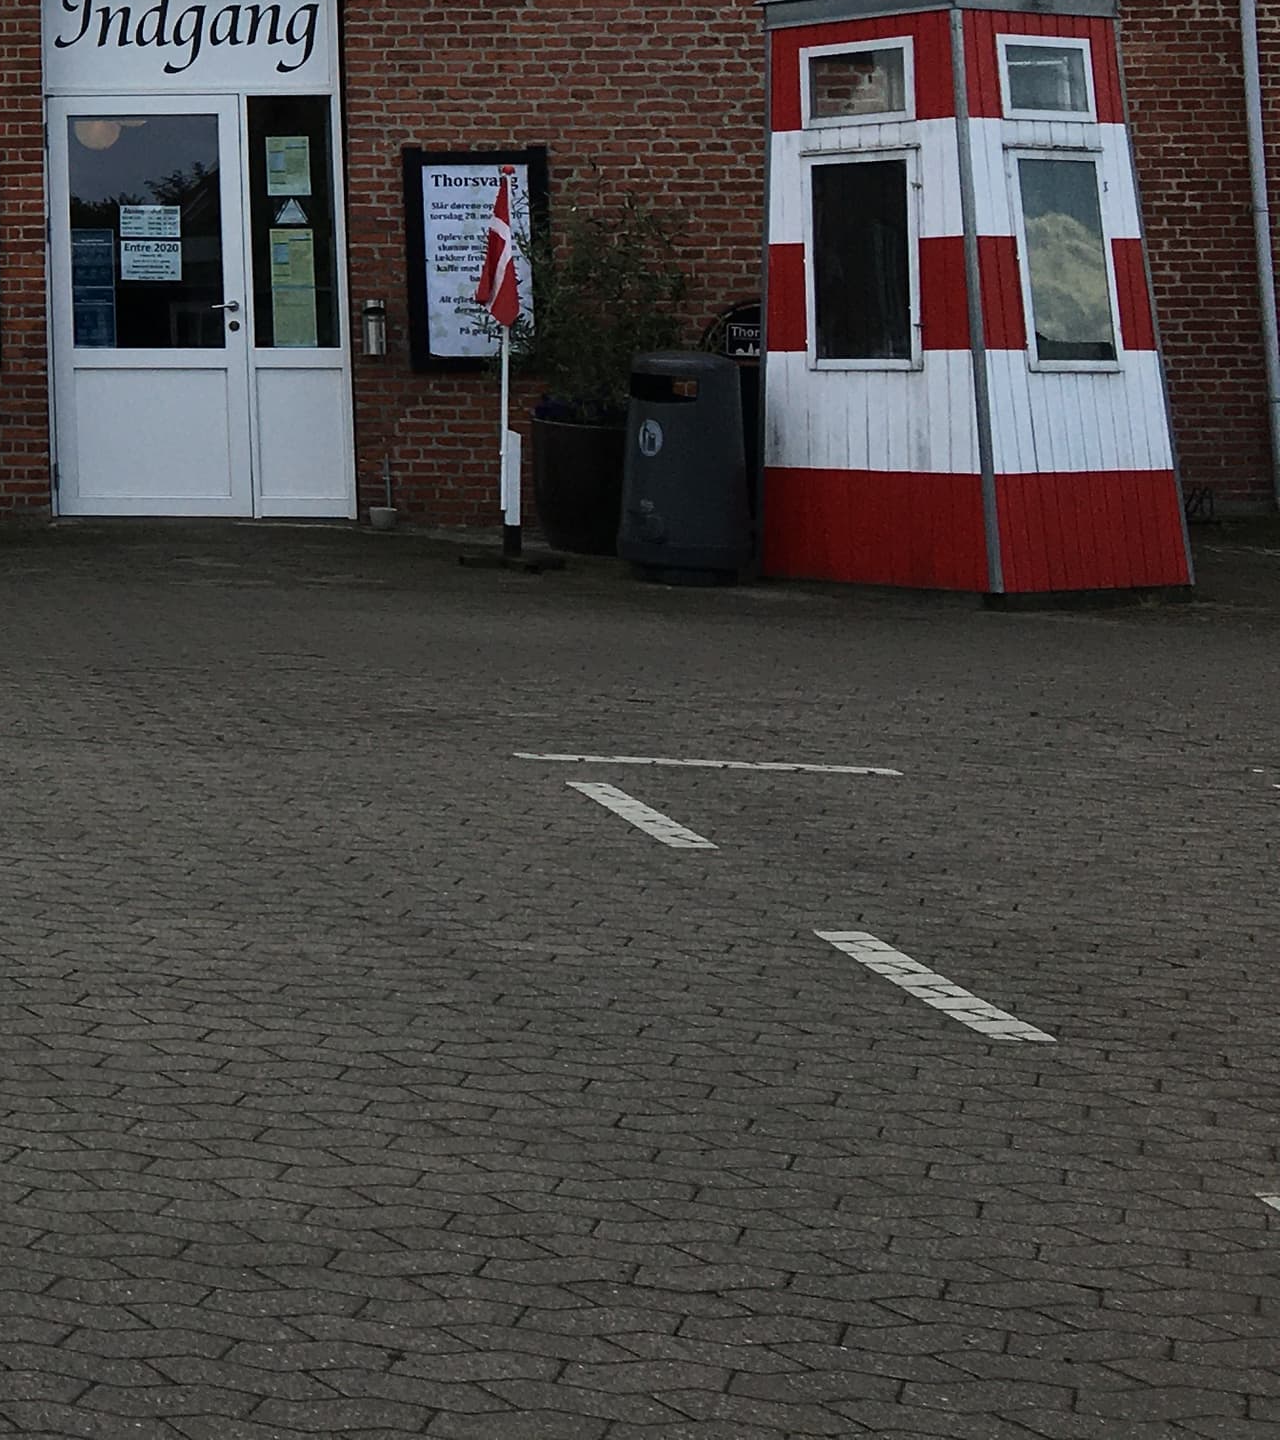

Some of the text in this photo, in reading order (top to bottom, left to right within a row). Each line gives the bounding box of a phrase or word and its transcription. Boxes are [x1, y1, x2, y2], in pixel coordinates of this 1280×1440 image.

[430, 212, 464, 221] torsdag
[437, 233, 462, 242] Oplev
[124, 243, 179, 253] Entre 2020
[730, 326, 761, 337] Thor
